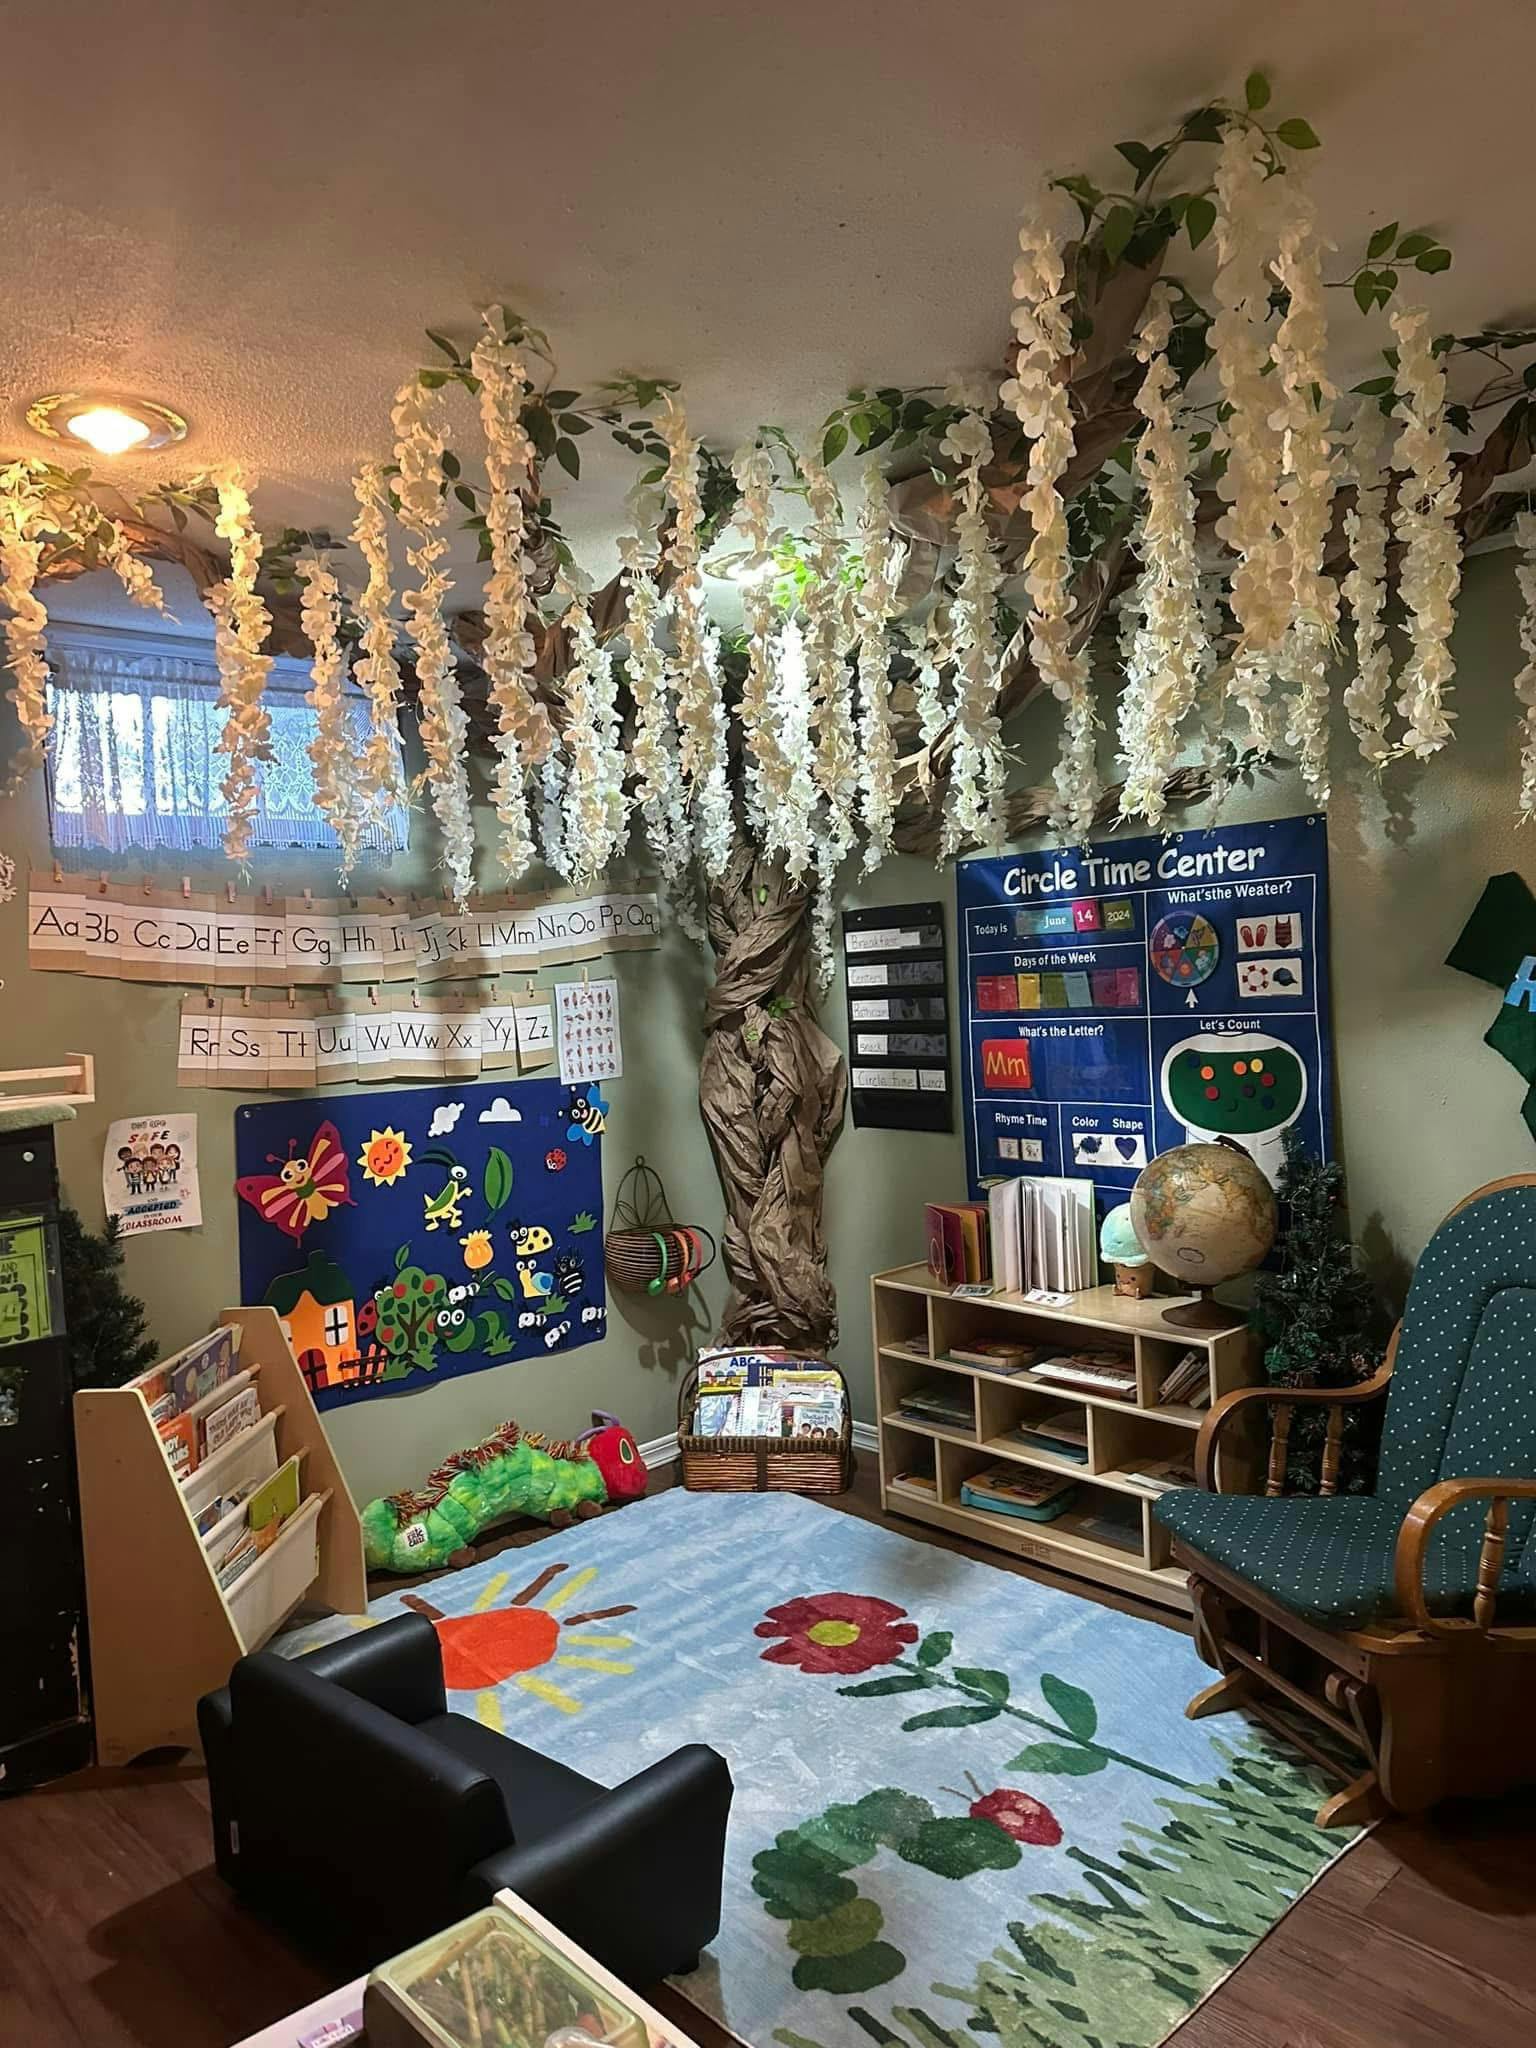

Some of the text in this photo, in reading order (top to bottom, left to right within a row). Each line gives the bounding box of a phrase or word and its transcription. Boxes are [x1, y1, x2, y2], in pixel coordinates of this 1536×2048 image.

[1003, 844, 1266, 896] Circle Time Center
[1234, 880, 1293, 898] Weater?
[974, 909, 1130, 936] Today is June 14 2024
[33, 906, 79, 937] Aa
[134, 920, 170, 949] Cc
[217, 927, 249, 954] Ee
[292, 927, 331, 965] Gg
[343, 927, 375, 952] Hh
[391, 926, 406, 951] Ii
[416, 926, 441, 961] Jj
[477, 923, 496, 947] Ll
[537, 917, 566, 938] Nn
[568, 912, 596, 935] Oo
[600, 905, 623, 935] Pp
[626, 904, 659, 935] Qq
[1014, 951, 1097, 969] Days of the Week
[1018, 1024, 1104, 1037] What's the Letter?
[1200, 1019, 1262, 1031] Let's Count
[191, 1016, 549, 1057] Rr Ss Tt Uu Vv Ww Xx Yy Zz
[985, 1051, 1027, 1077] Mm
[995, 1113, 1048, 1127] Rhyme Time
[1072, 1116, 1144, 1131] Color Shape
[128, 1130, 170, 1143] SAFE
